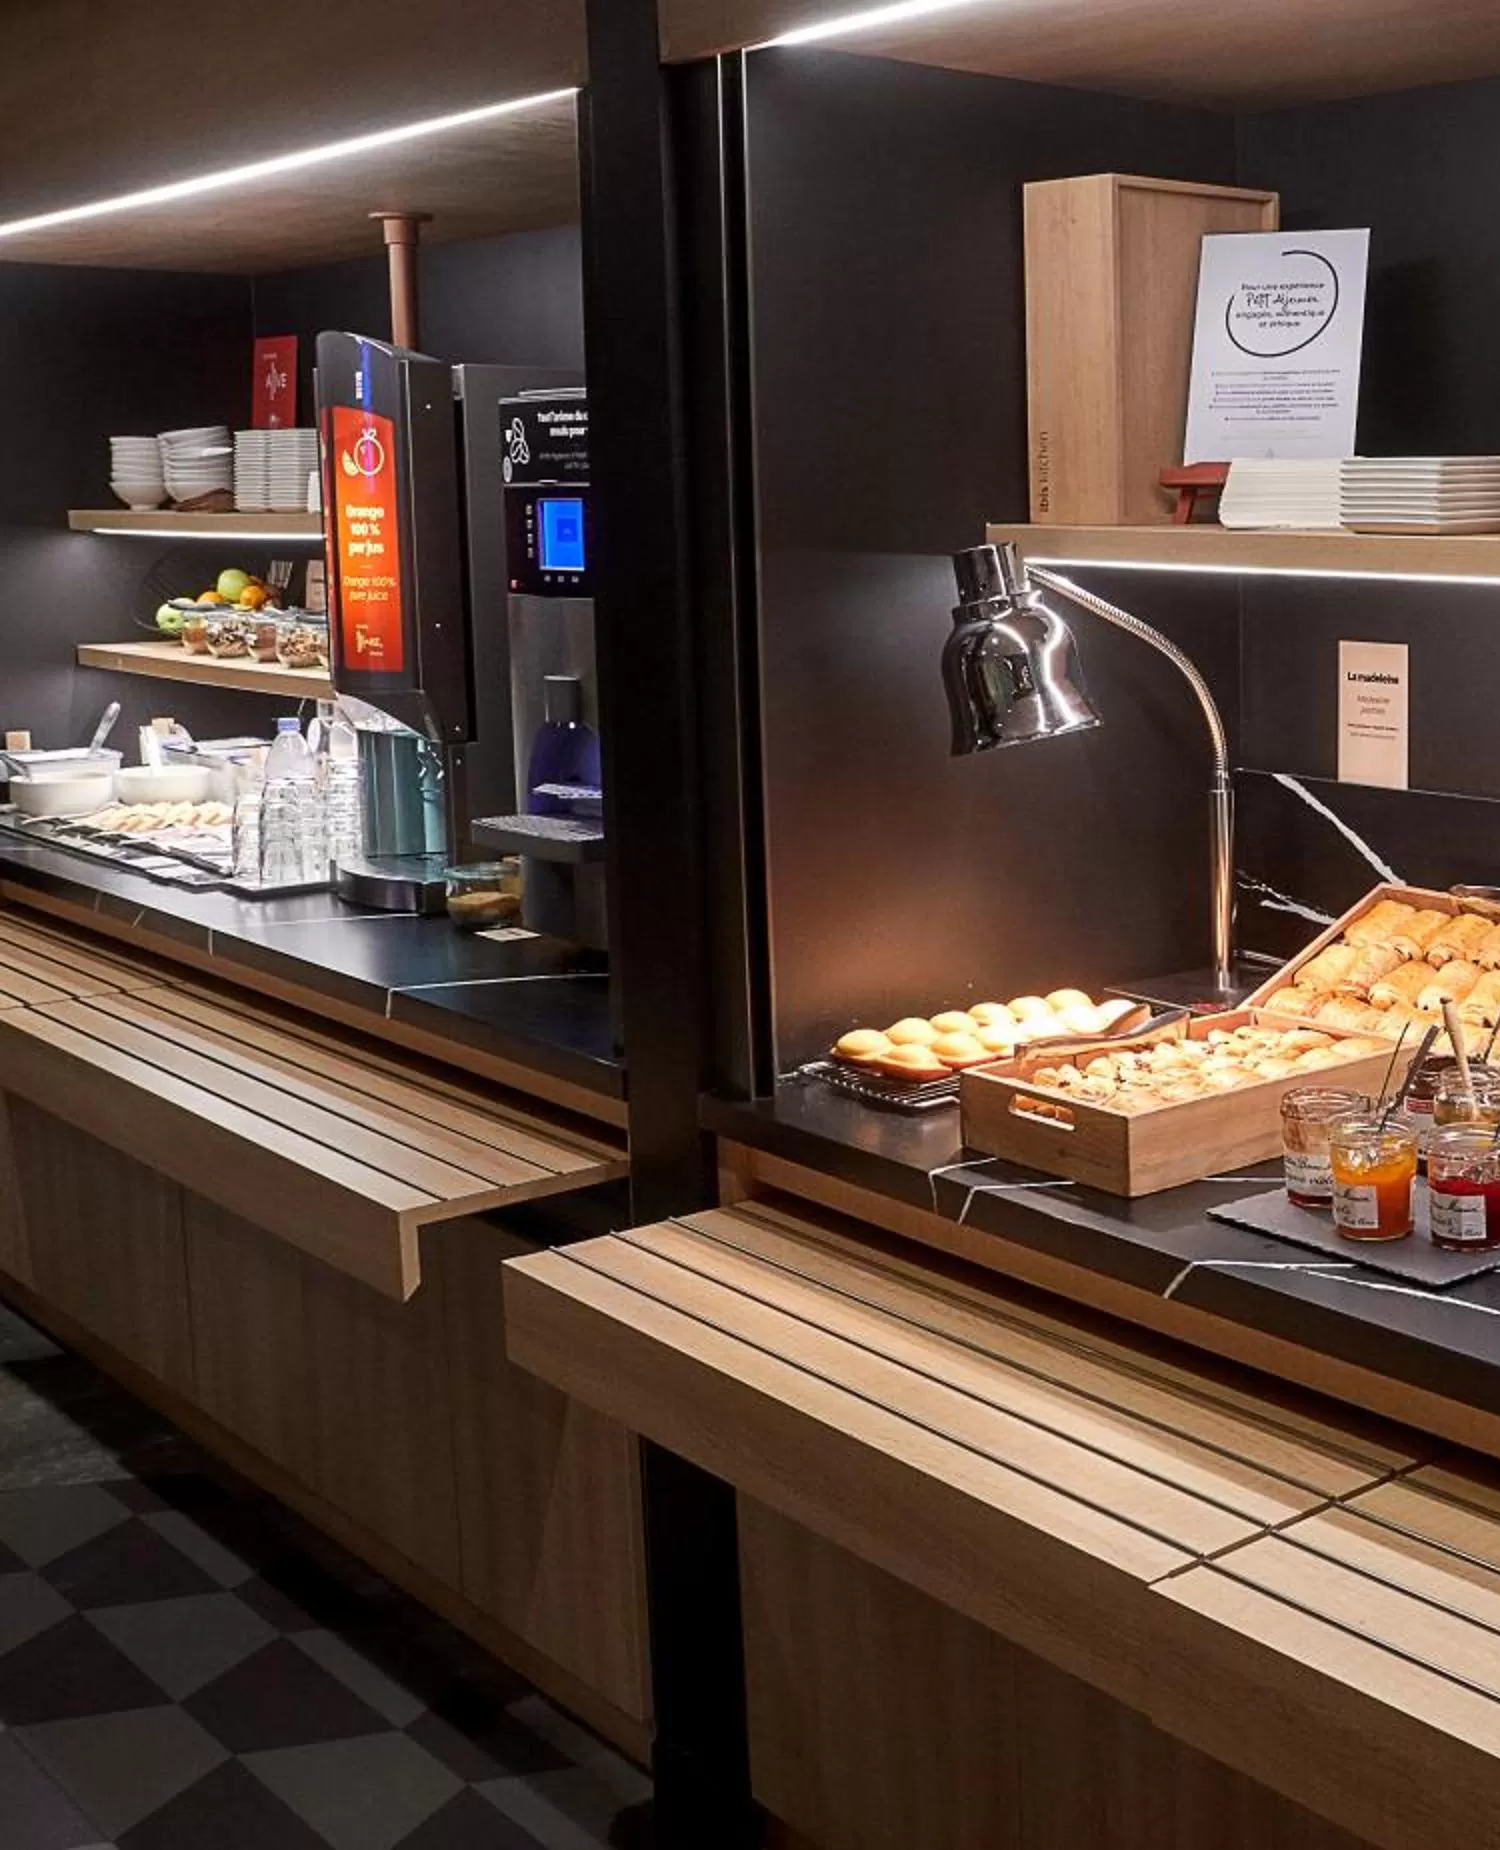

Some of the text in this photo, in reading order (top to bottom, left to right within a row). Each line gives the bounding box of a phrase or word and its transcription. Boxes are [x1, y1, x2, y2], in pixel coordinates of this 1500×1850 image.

[1036, 430, 1049, 513] ibis kitchen
[345, 504, 385, 521] Orange
[1347, 671, 1399, 685] La madeleine
